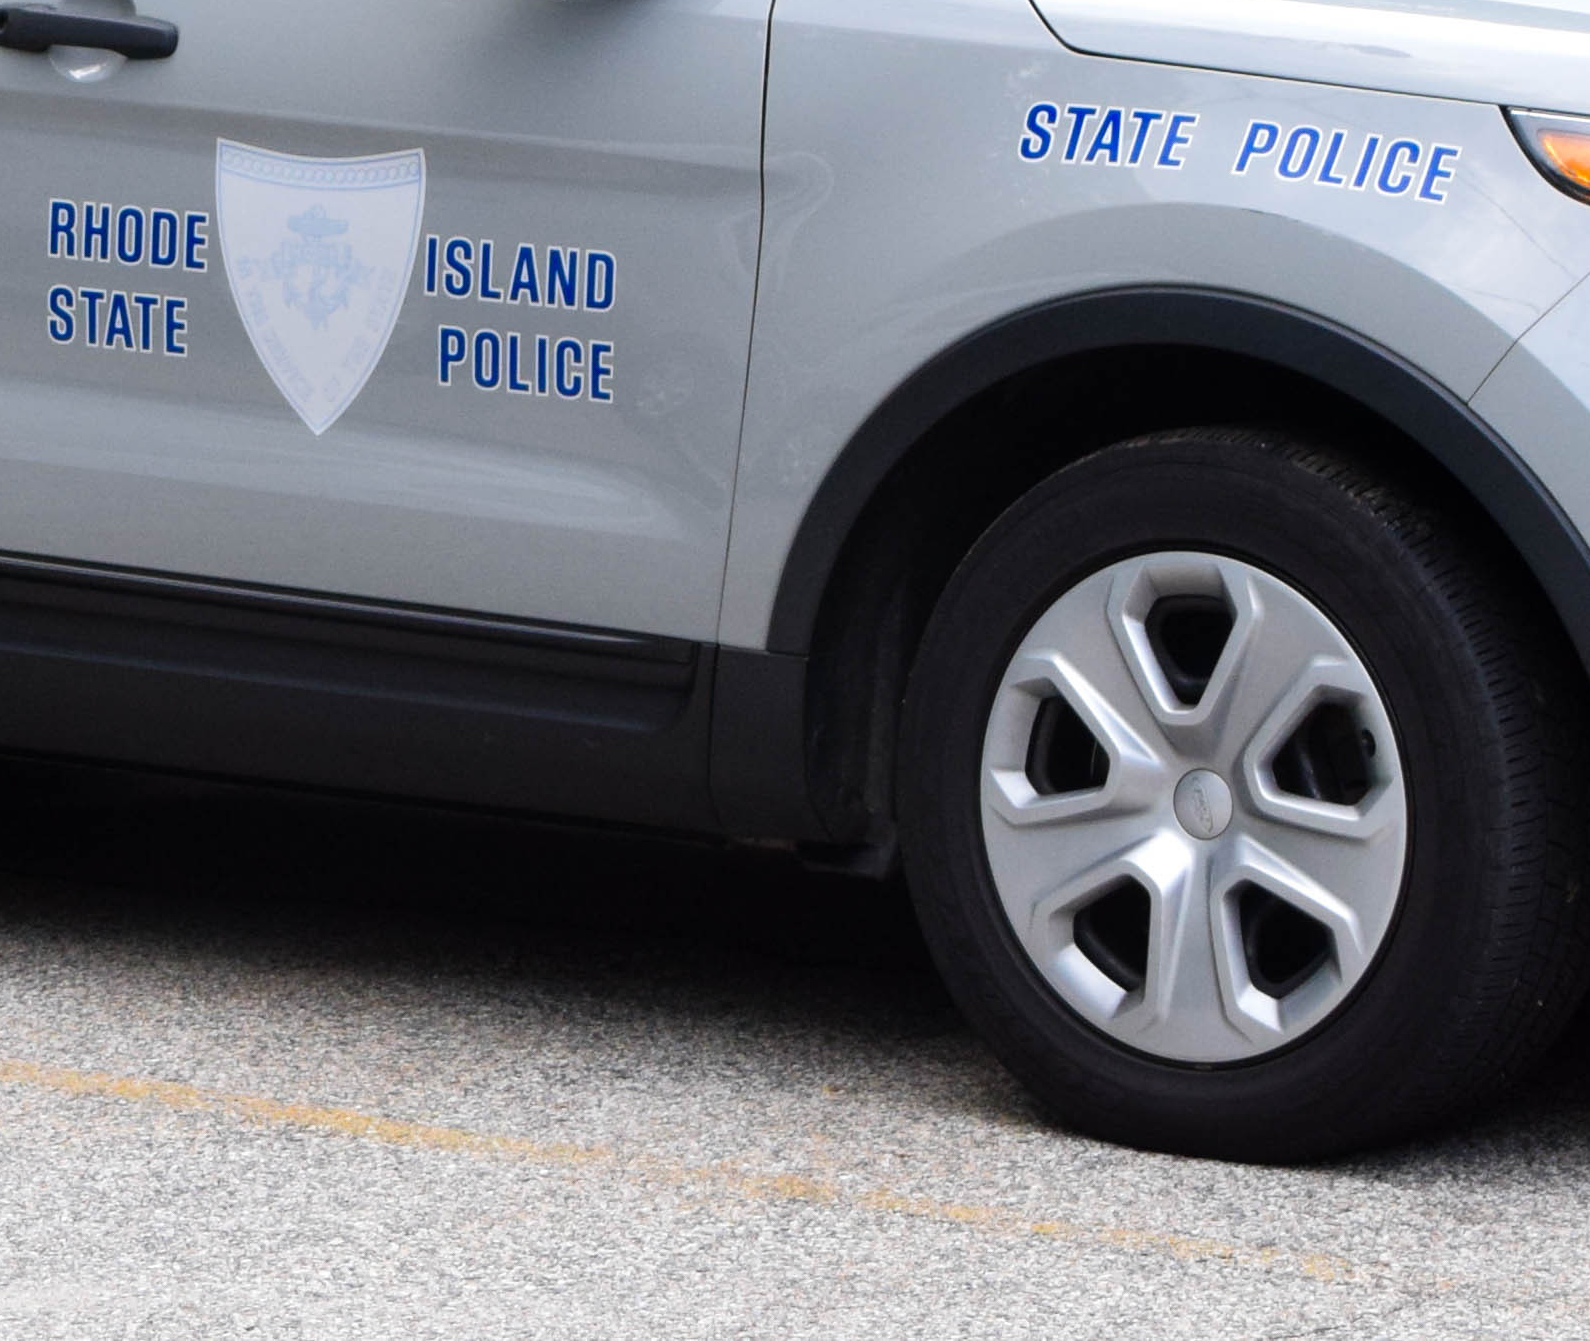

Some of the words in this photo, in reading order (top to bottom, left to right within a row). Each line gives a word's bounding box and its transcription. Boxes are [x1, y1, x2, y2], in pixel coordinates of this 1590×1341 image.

[1019, 101, 1199, 170] STATE
[1232, 120, 1462, 204] POLICE
[48, 198, 208, 272] RHODE
[424, 234, 617, 313] ISLAND
[48, 286, 188, 356] STATE
[438, 325, 614, 403] POLICE
